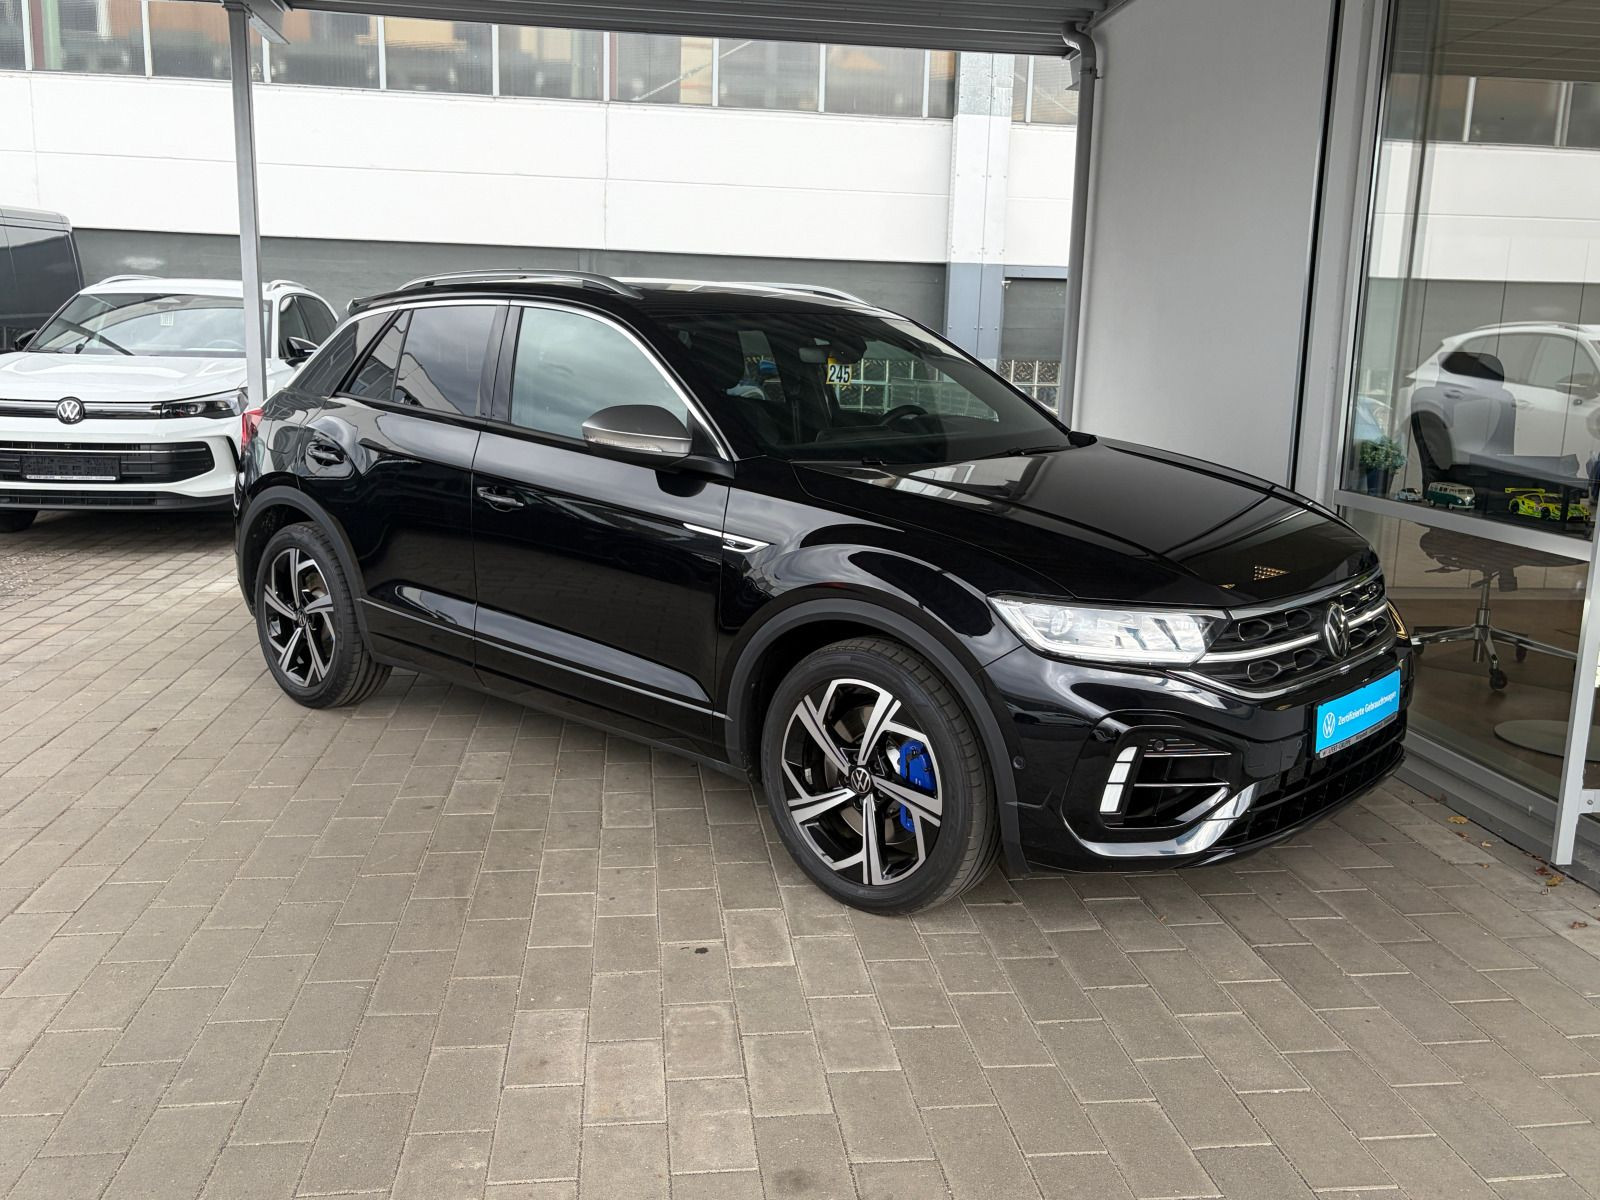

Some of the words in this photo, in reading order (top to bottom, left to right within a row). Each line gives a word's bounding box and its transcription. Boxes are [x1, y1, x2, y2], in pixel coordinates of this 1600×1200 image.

[829, 364, 850, 383] 245
[57, 398, 83, 423] VW
[1322, 711, 1336, 739] VW
[851, 767, 871, 794] VW
